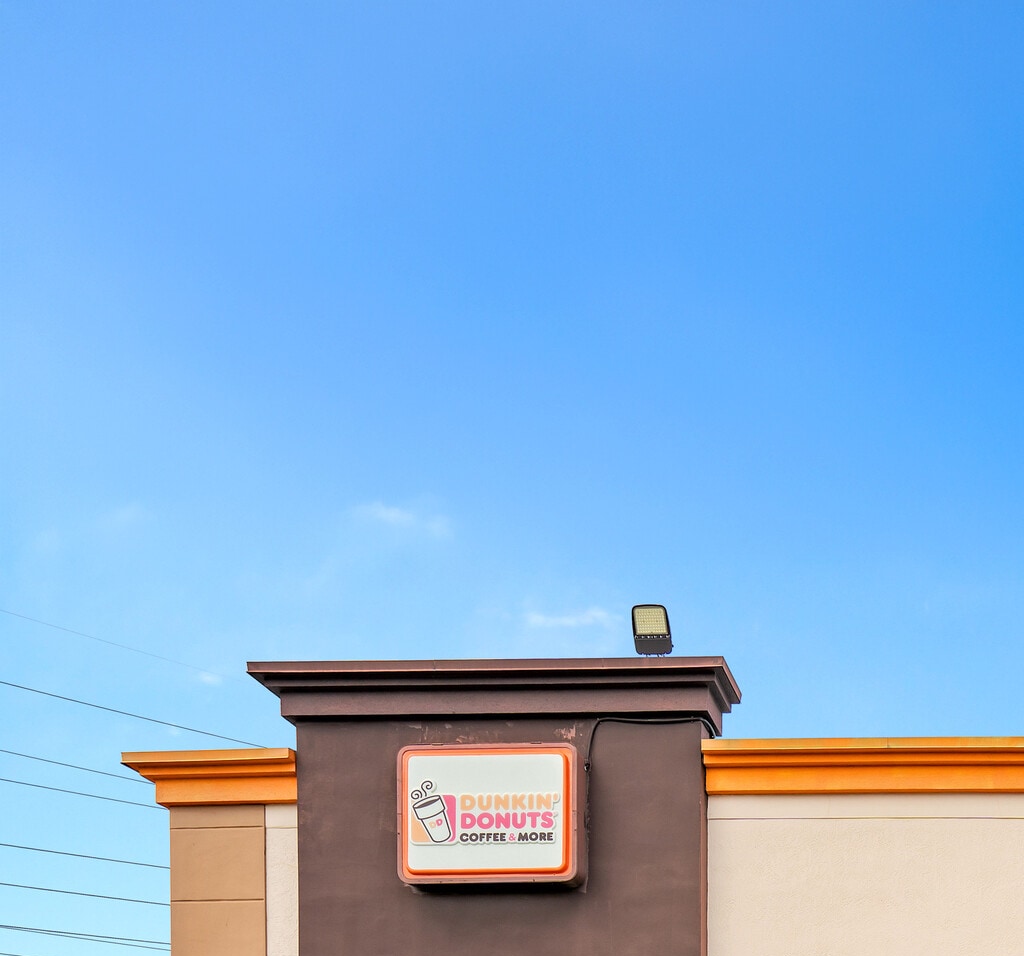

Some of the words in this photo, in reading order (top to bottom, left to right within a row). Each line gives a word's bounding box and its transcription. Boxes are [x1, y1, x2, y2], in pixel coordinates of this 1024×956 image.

[460, 794, 558, 810] DUNKIN'
[460, 811, 554, 829] DONUTS
[459, 832, 506, 842] COFFEE
[508, 831, 516, 842] &
[517, 831, 554, 842] MORE
